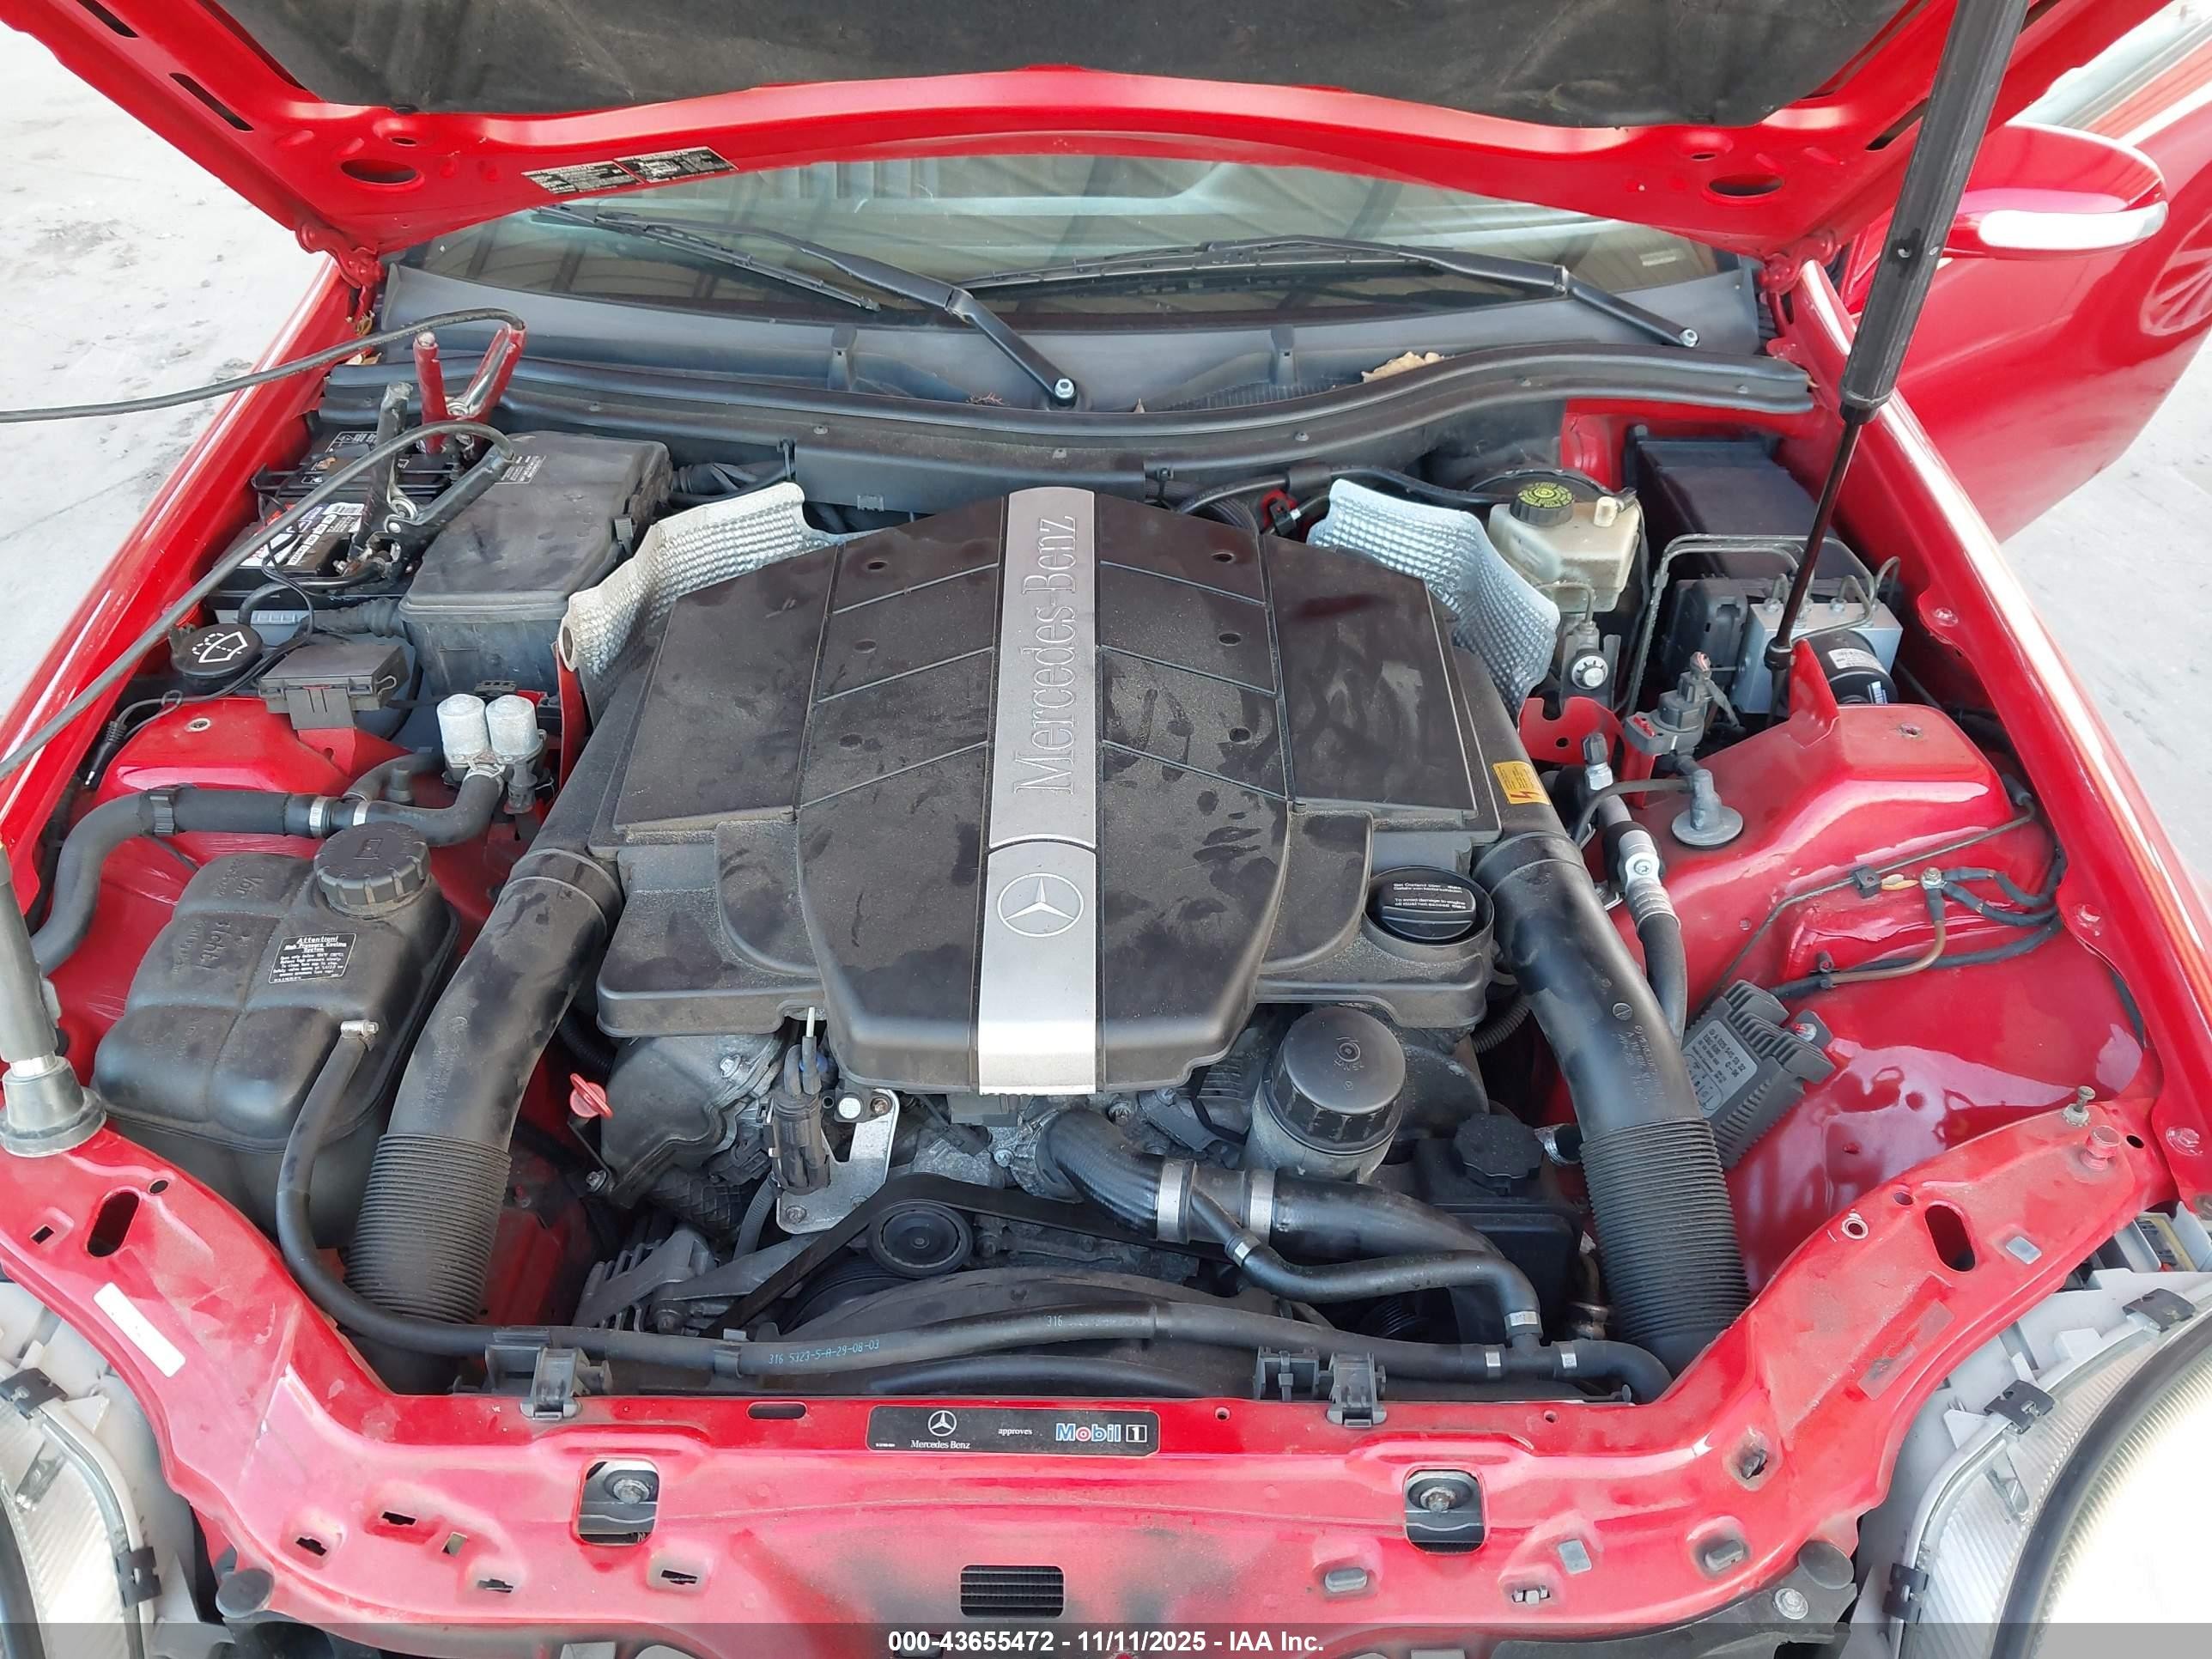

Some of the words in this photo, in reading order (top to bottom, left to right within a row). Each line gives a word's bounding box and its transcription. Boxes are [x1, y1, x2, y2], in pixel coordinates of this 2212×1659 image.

[1013, 515, 1078, 796] Mercedes-Benz
[296, 935, 339, 945] Attention!
[1047, 1315, 1063, 1327] 316
[769, 1353, 784, 1364] 316
[910, 1438, 949, 1449] Mercedes
[950, 1440, 971, 1449] Benz
[998, 1428, 1033, 1437] approves
[1055, 1423, 1121, 1443] Mobil
